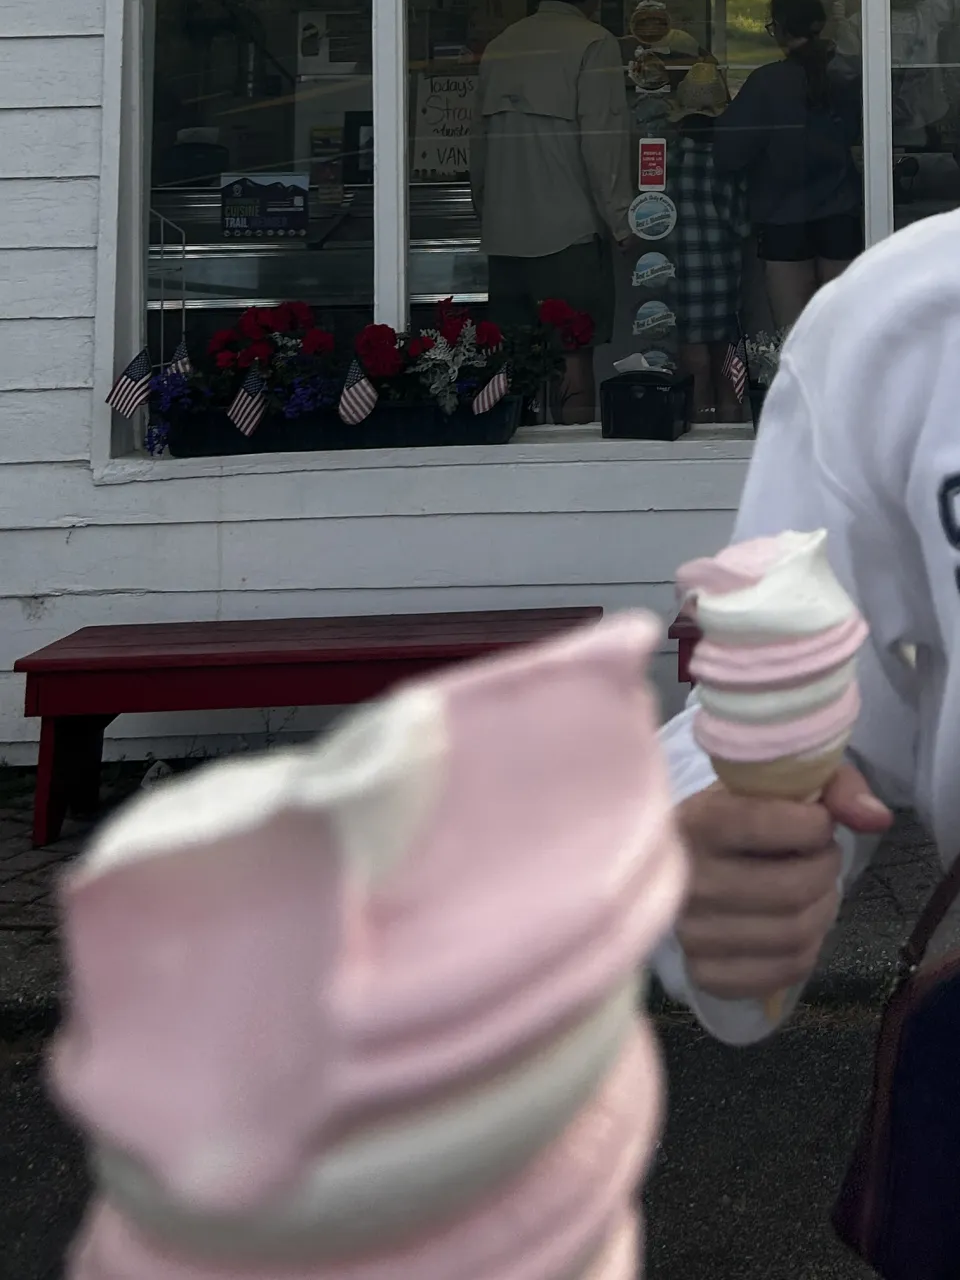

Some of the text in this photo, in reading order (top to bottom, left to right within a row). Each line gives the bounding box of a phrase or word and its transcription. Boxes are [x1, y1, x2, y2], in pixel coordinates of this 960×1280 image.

[424, 74, 474, 98] Today's
[426, 94, 472, 125] Stra
[437, 146, 469, 166] VAN
[224, 205, 261, 217] CUISINE
[224, 217, 249, 228] TRAIL
